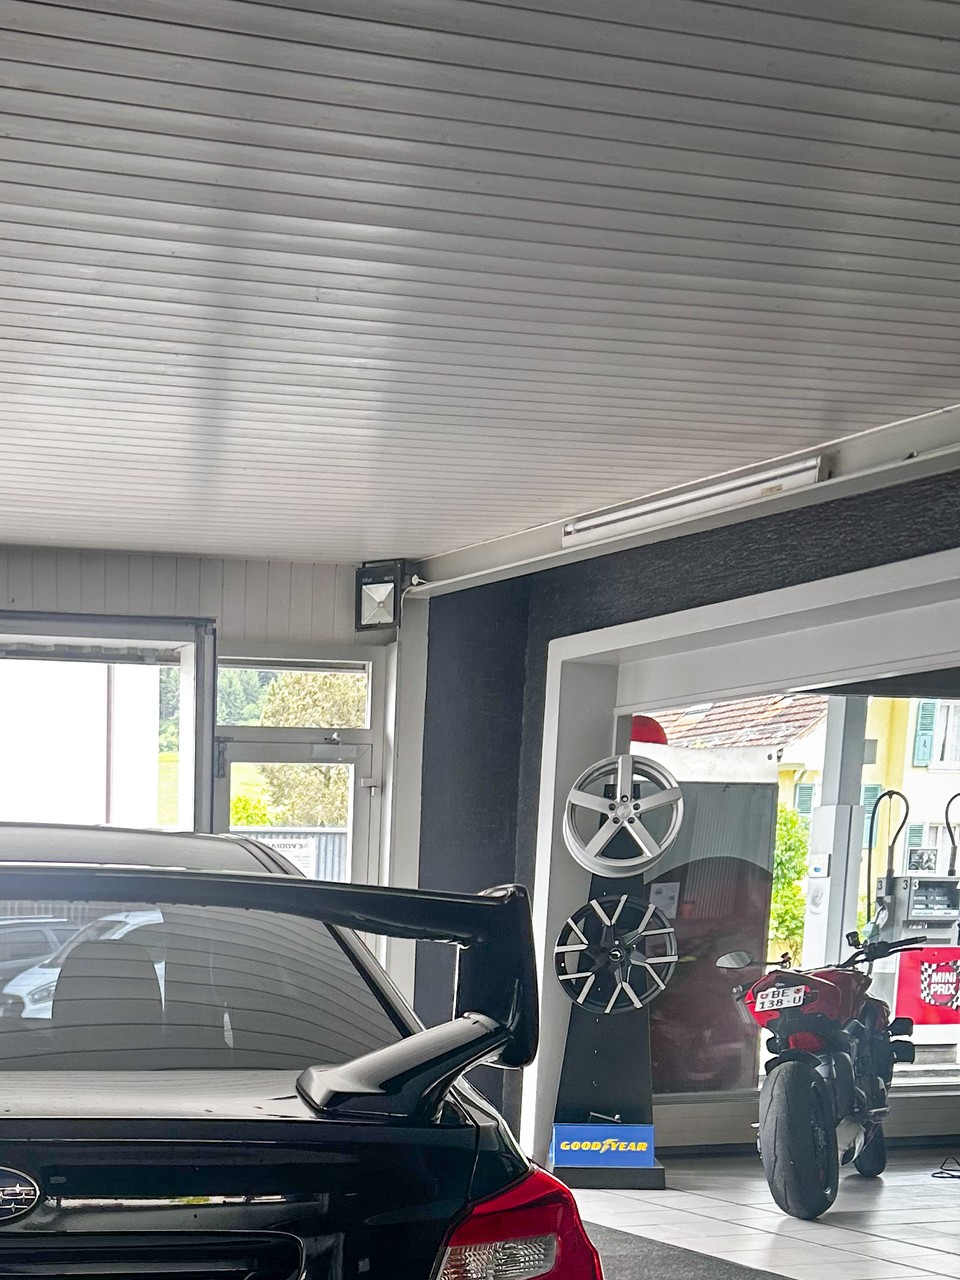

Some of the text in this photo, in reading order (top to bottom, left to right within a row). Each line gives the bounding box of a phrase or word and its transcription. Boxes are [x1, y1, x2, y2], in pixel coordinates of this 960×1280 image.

[877, 880, 883, 890] 3
[903, 880, 909, 890] 3
[913, 880, 919, 890] 3
[931, 972, 957, 983] MINI
[771, 989, 790, 999] BE
[930, 984, 957, 995] PRIX
[560, 1139, 648, 1153] GOODYEAR
